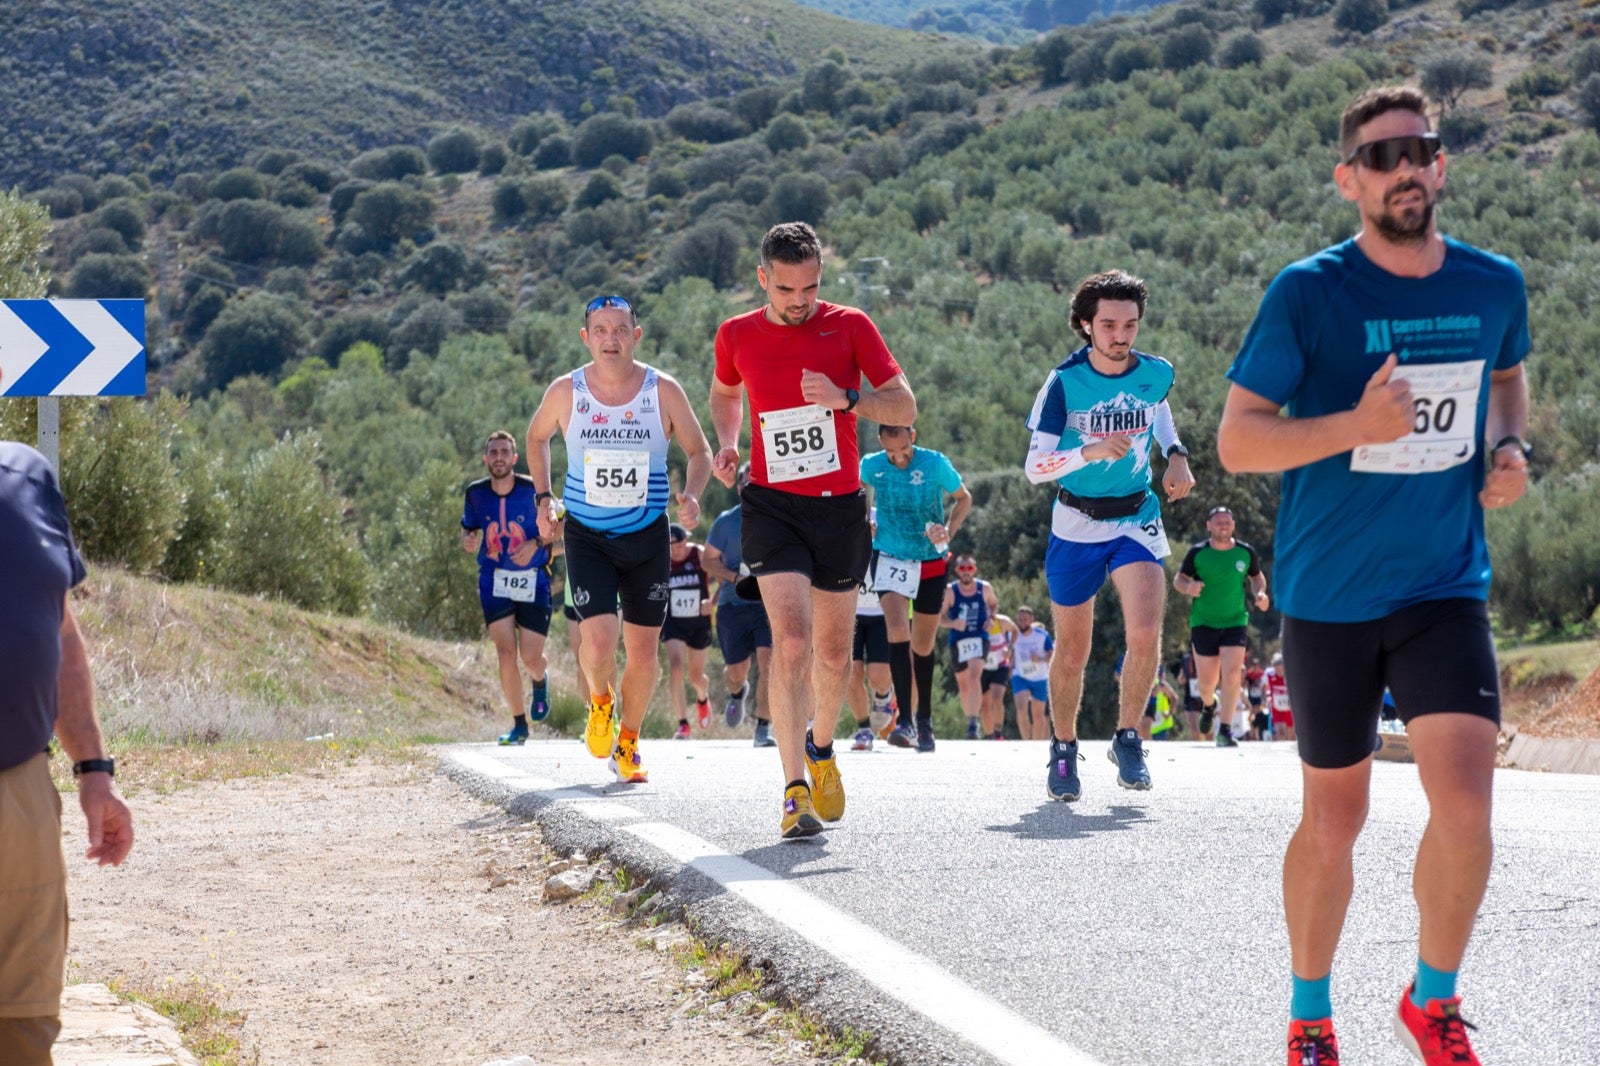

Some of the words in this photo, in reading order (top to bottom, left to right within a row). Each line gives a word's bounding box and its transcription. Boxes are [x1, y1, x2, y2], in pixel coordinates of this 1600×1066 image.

[1364, 319, 1392, 353] XI
[580, 428, 651, 440] MARACENA
[774, 426, 825, 457] 558
[595, 467, 638, 488] 554
[502, 576, 529, 589] 182
[890, 566, 908, 583] 73
[675, 598, 695, 608] 417
